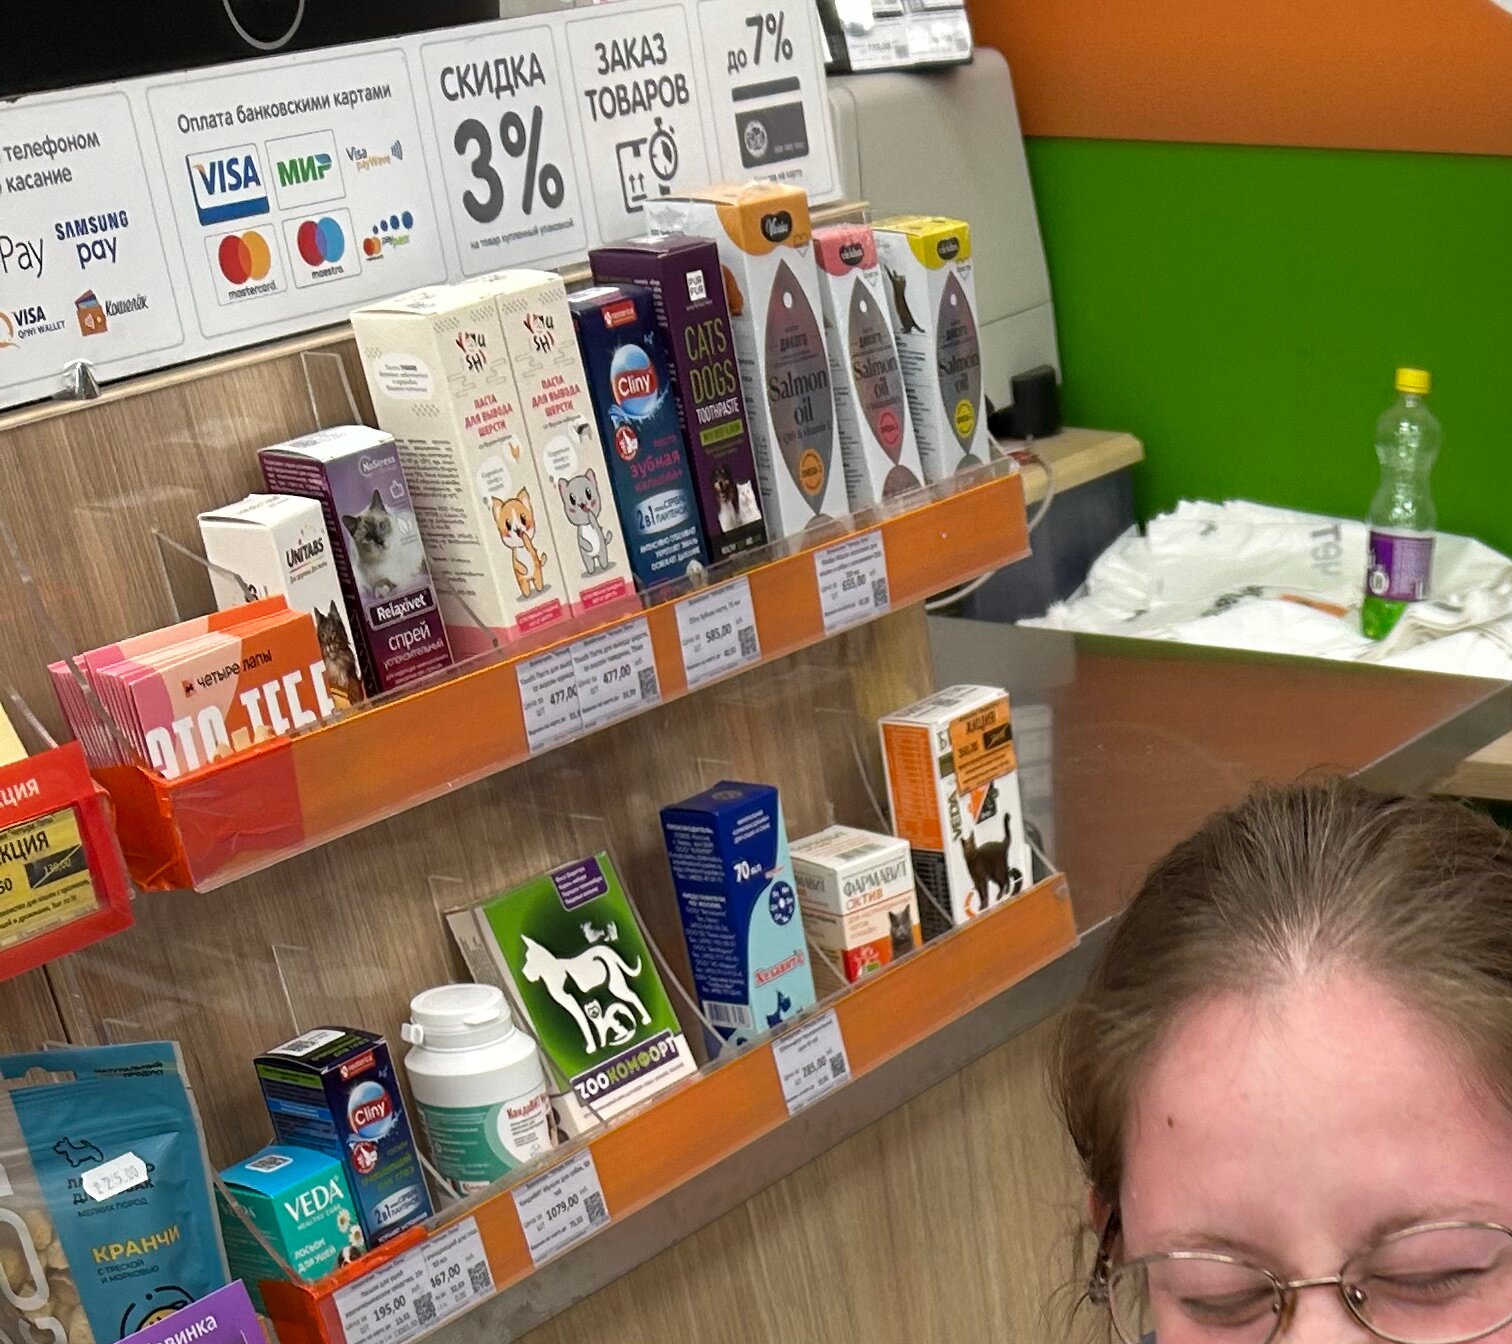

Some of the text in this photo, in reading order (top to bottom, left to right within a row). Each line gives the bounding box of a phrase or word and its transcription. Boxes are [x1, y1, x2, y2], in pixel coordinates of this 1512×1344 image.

[594, 32, 667, 75] ЗАКАЗ
[727, 11, 793, 73] до 7%
[440, 52, 546, 101] СКИДКА
[178, 83, 392, 133] Оплата банковскими картами
[585, 74, 689, 121] ТОВАРОВ
[3, 131, 100, 162] телефоном
[6, 166, 73, 193] касание
[193, 154, 261, 195] VISA
[277, 153, 332, 187] МИР
[454, 105, 564, 223] 3%
[55, 210, 129, 240] SAMSUNG
[0, 235, 44, 278] Pay
[76, 237, 117, 270] pay
[12, 306, 46, 327] VISA
[684, 318, 727, 361] CATS
[617, 372, 651, 396] Cliny
[689, 359, 737, 404] DOGS
[768, 370, 828, 403] Salmon
[286, 537, 325, 569] UNITABS
[376, 594, 427, 622] Relaxivet
[387, 620, 432, 652] спрей
[197, 650, 273, 690] четыре лапы
[603, 664, 632, 684] 477,00
[550, 683, 578, 705] 477,00
[0, 830, 49, 866] КЦИЯ
[733, 861, 750, 883] 70
[843, 860, 908, 898] ФАРМАВИТ
[354, 1101, 386, 1127] Cliny
[284, 1178, 344, 1222] VEDA
[545, 1194, 579, 1222] 1079,00
[91, 1224, 180, 1264] КРАНЧИ
[430, 1263, 461, 1289] 167,00
[373, 1295, 407, 1322] 195,00
